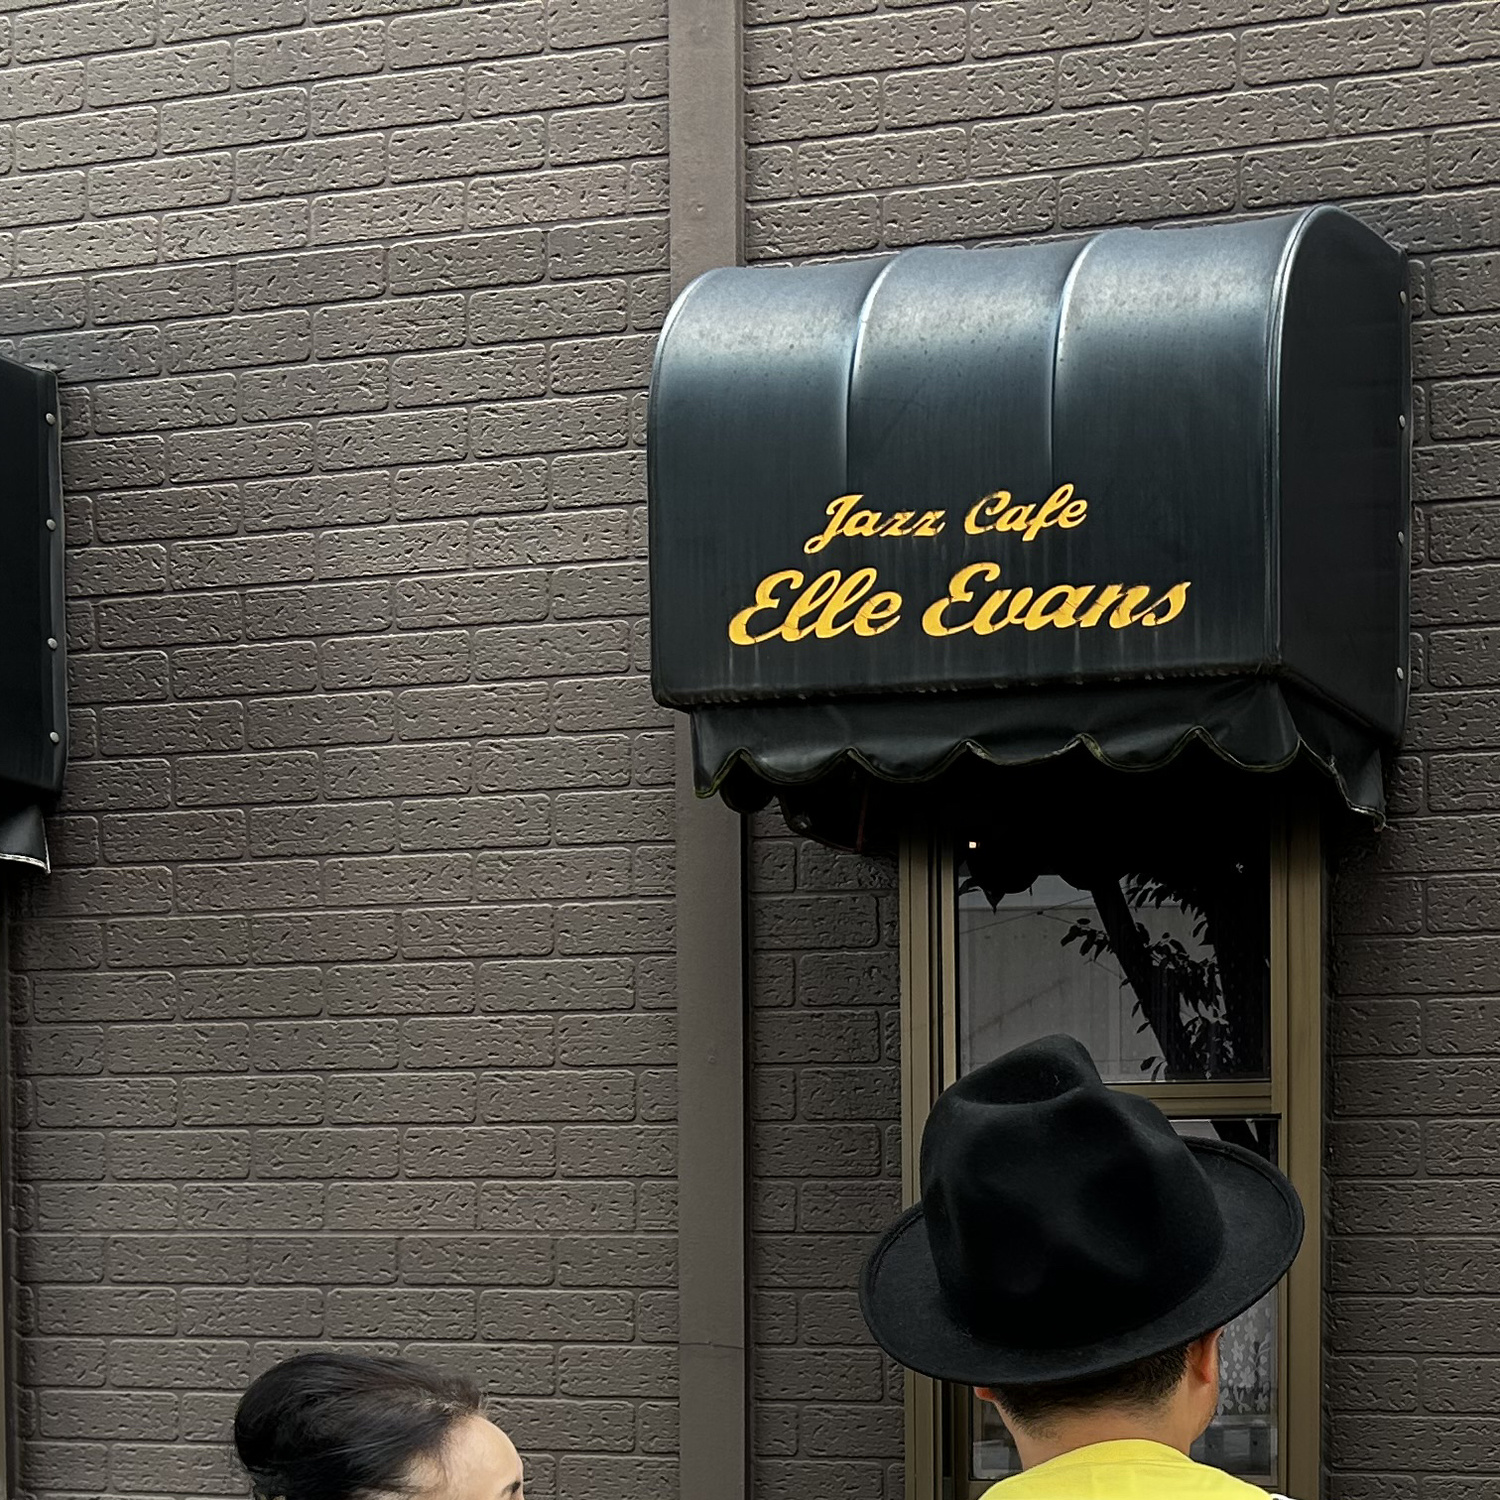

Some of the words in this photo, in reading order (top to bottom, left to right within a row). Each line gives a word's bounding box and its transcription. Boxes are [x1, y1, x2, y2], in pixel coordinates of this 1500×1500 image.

[803, 494, 946, 555] Jazz
[964, 483, 1088, 542] Cafe
[727, 566, 902, 646] Elle
[921, 562, 1192, 637] Evans
